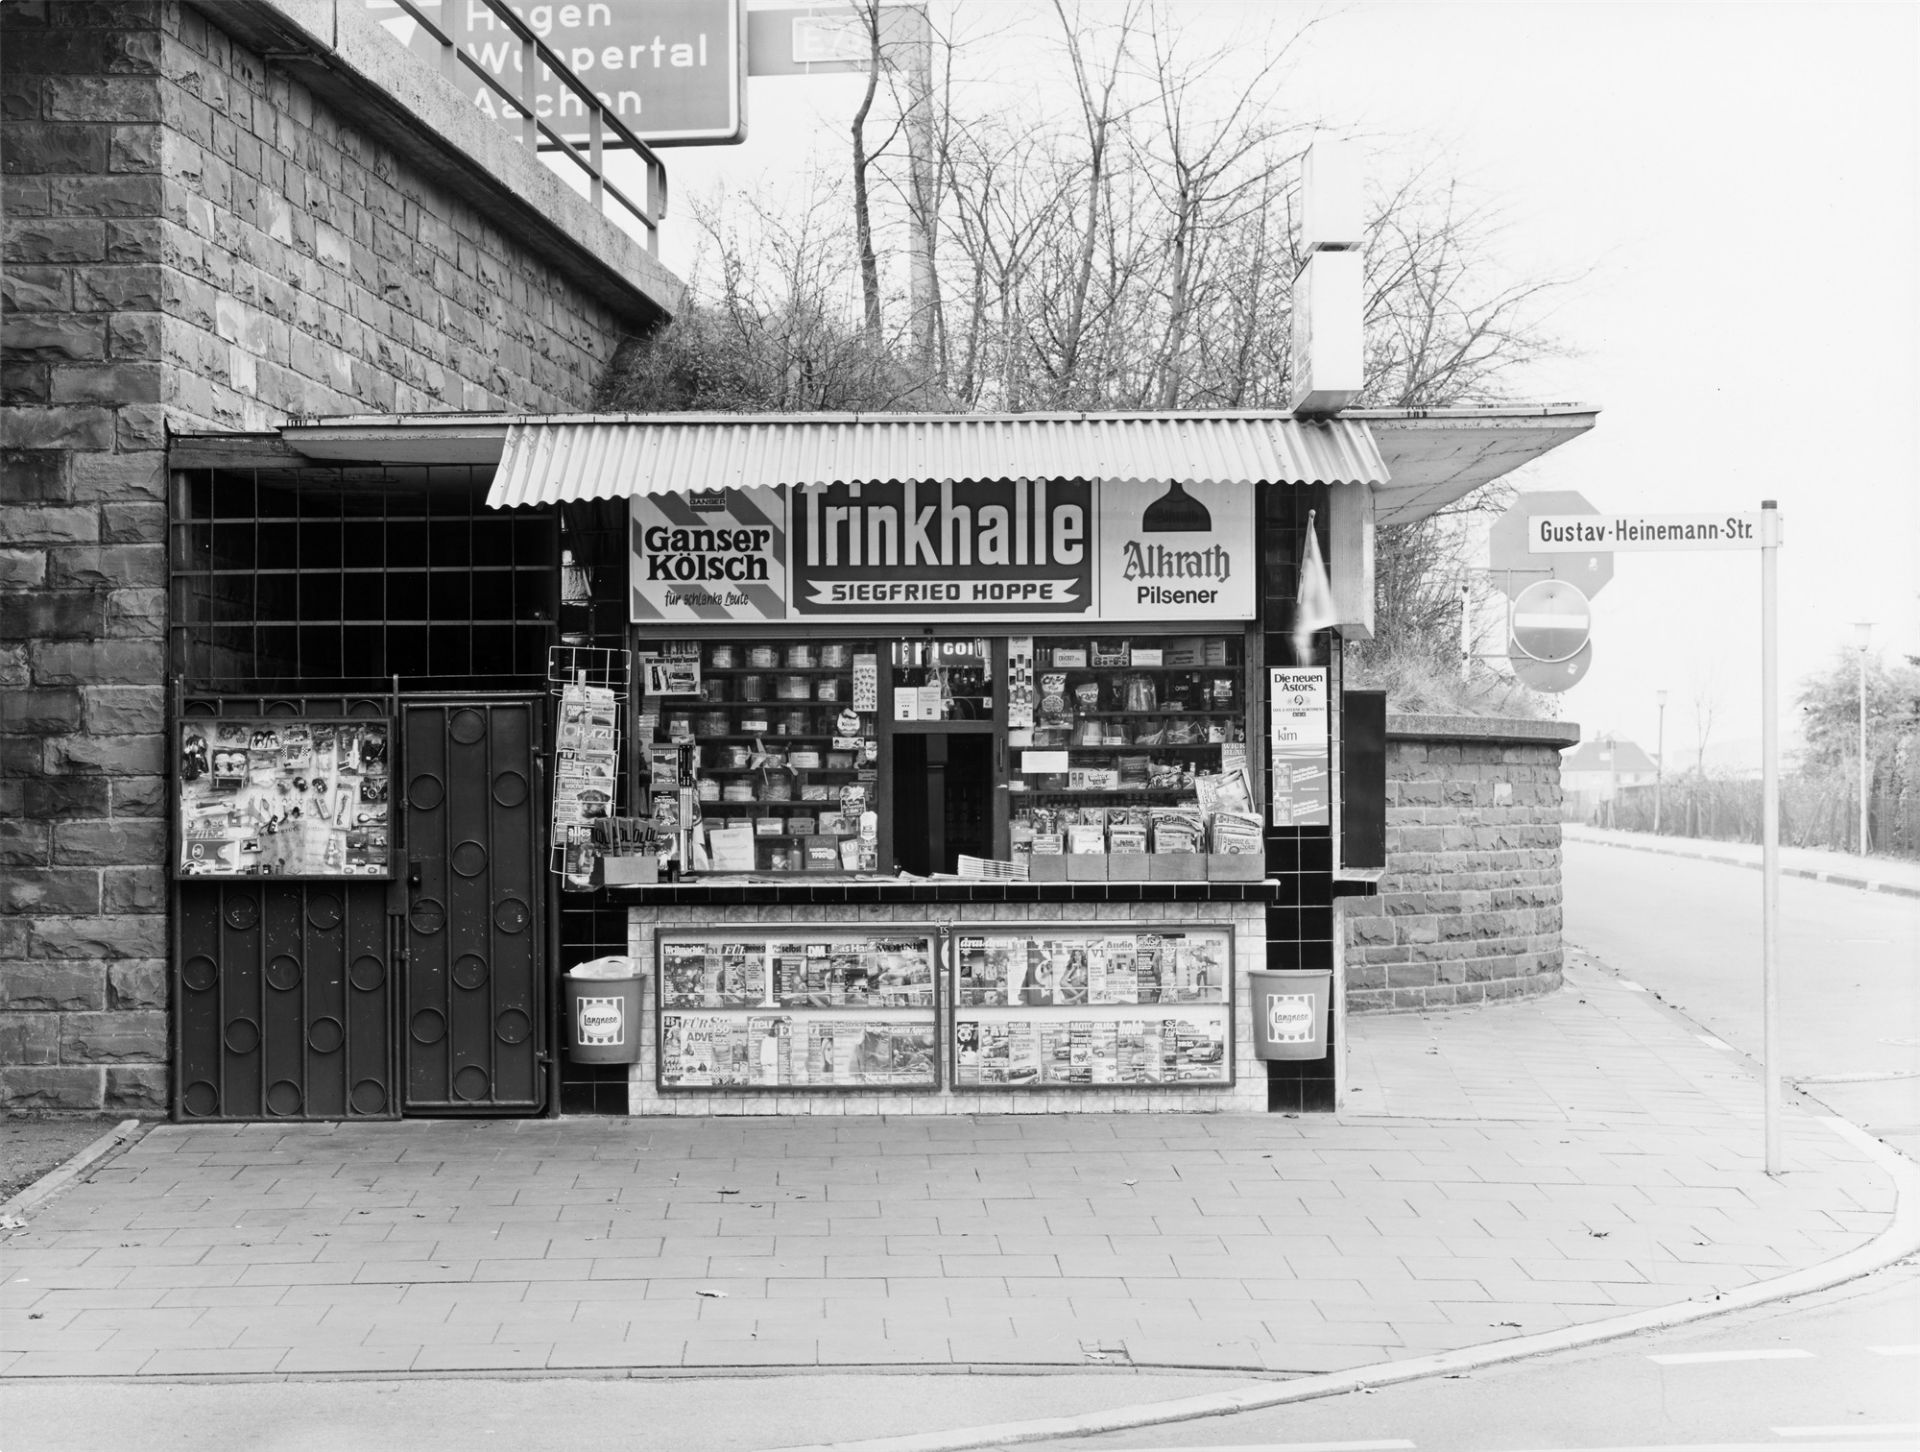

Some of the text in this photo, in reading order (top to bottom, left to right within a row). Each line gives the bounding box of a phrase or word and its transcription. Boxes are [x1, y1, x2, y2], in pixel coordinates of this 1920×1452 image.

[800, 478, 1084, 566] Trinkhalle
[1540, 517, 1753, 542] Gustav-Heinemann-Str.
[645, 526, 770, 552] Ganser
[646, 553, 770, 581] Kölsch
[665, 590, 682, 607] für
[683, 592, 723, 606] schlanke
[832, 583, 1054, 601] SIEGFRIED HOPPE
[1137, 586, 1219, 604] Pilsener
[1274, 673, 1323, 683] Die neuen
[1281, 683, 1317, 692] Astors.
[1277, 726, 1298, 741] kim
[583, 1014, 618, 1026] Langnese
